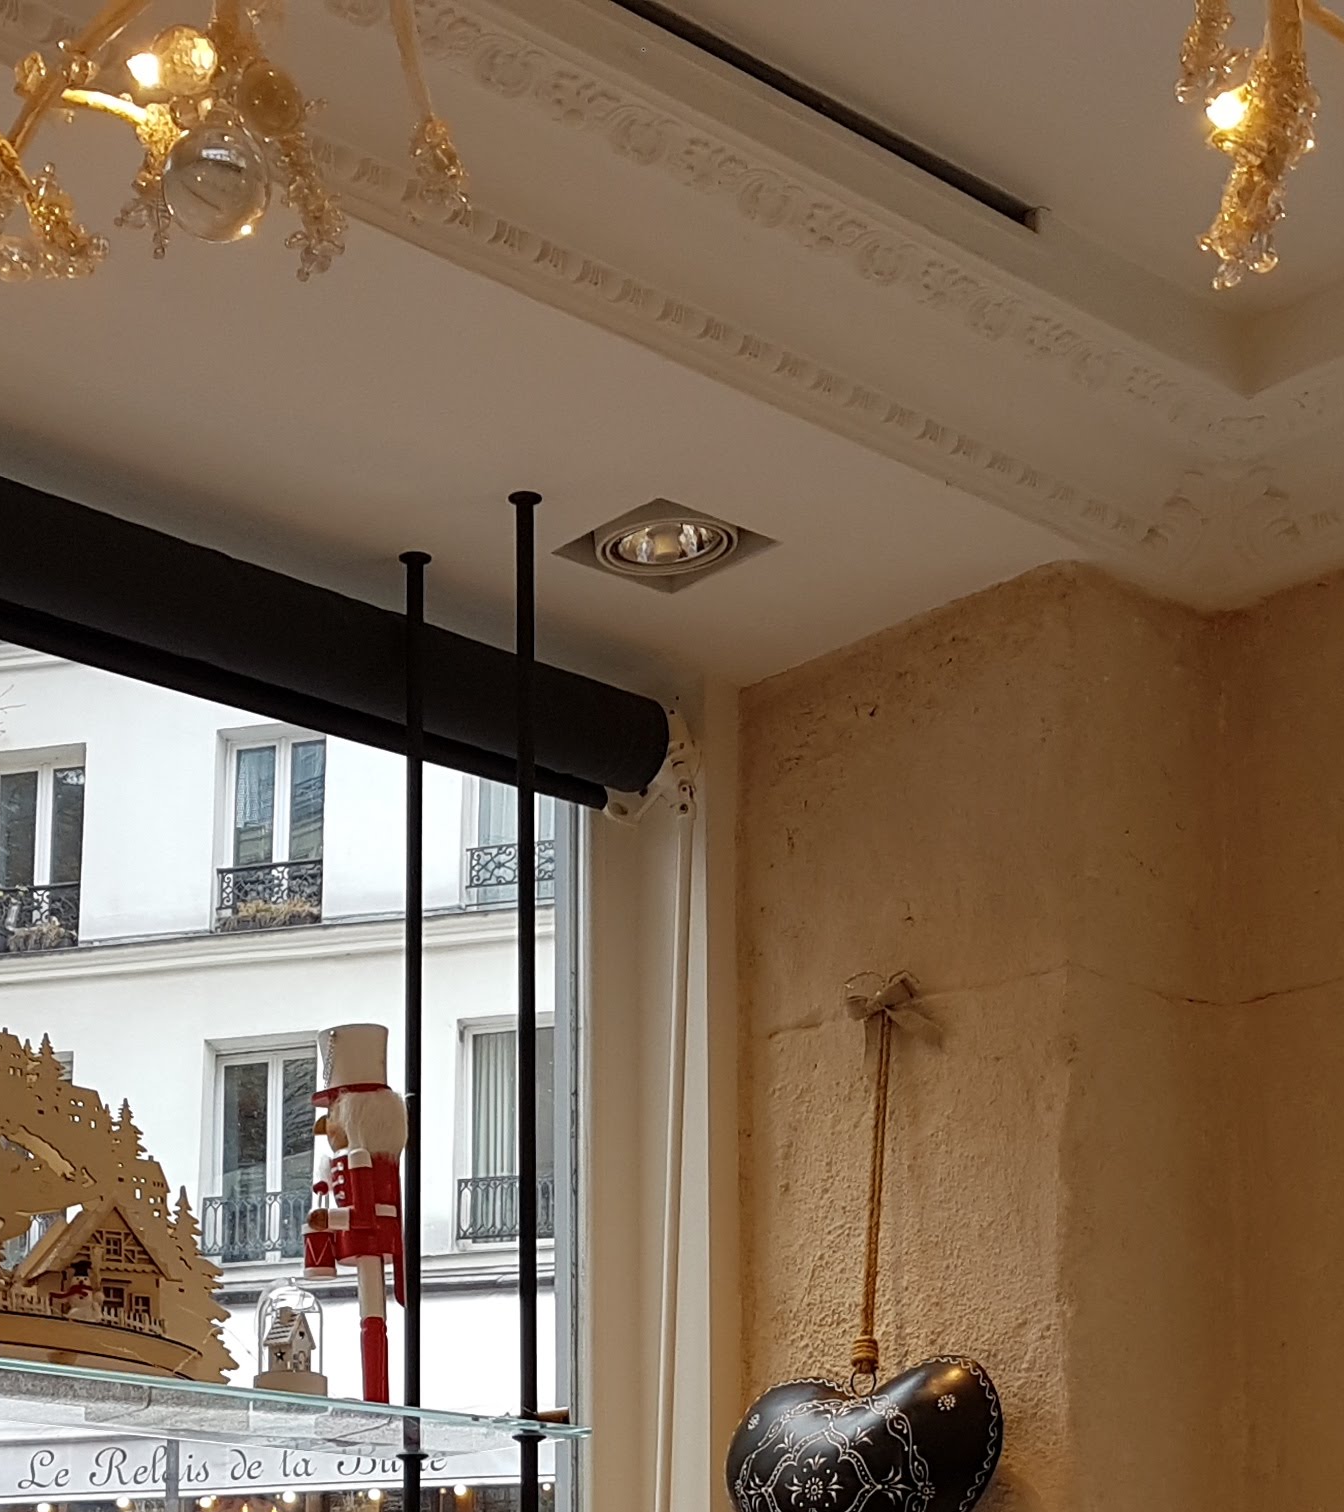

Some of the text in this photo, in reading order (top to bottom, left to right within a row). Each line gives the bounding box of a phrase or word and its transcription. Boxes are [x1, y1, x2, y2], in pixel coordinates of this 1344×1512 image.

[17, 1445, 448, 1490] Le Relis de la Bue
